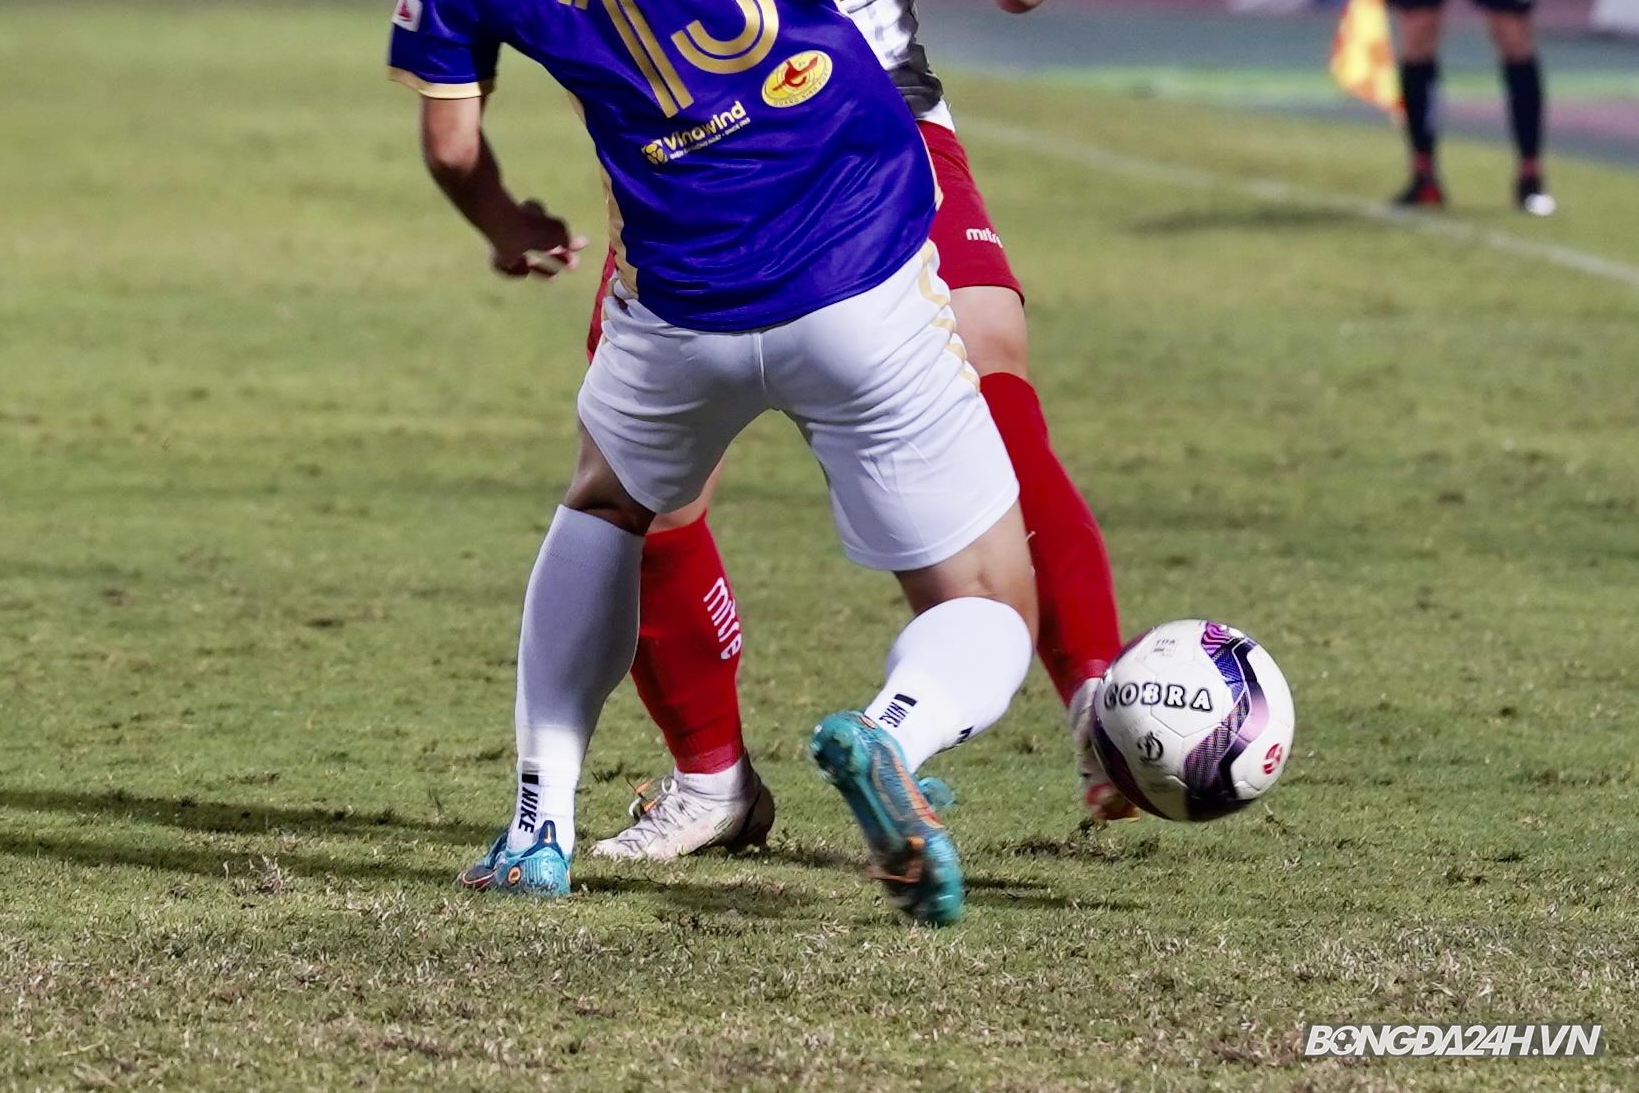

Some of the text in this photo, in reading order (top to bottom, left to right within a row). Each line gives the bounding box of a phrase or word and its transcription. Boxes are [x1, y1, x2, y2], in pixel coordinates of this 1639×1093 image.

[703, 576, 743, 660] mitre
[879, 701, 909, 728] NIKE
[518, 786, 539, 834] NIKE
